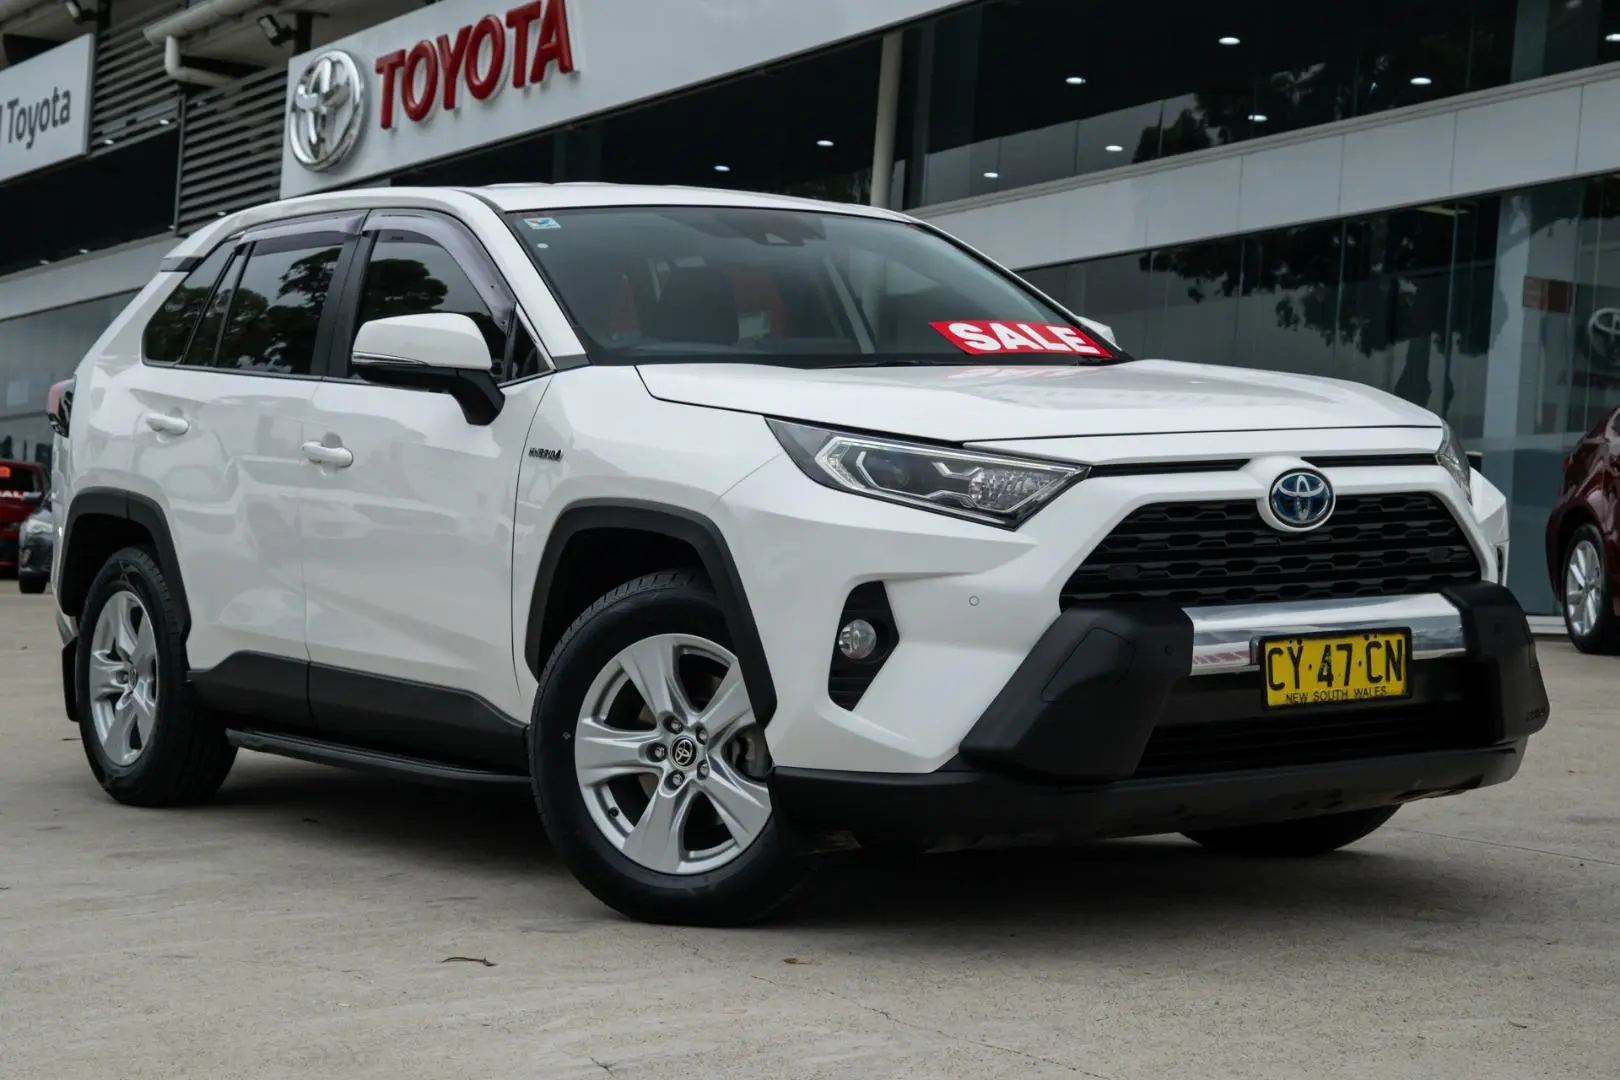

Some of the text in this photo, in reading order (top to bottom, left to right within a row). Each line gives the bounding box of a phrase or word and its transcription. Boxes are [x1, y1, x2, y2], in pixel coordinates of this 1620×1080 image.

[375, 0, 574, 130] TOYOTA
[7, 86, 71, 150] Toyota
[948, 322, 1100, 354] SALE
[1286, 686, 1387, 704] NEW SOUTH WALES
